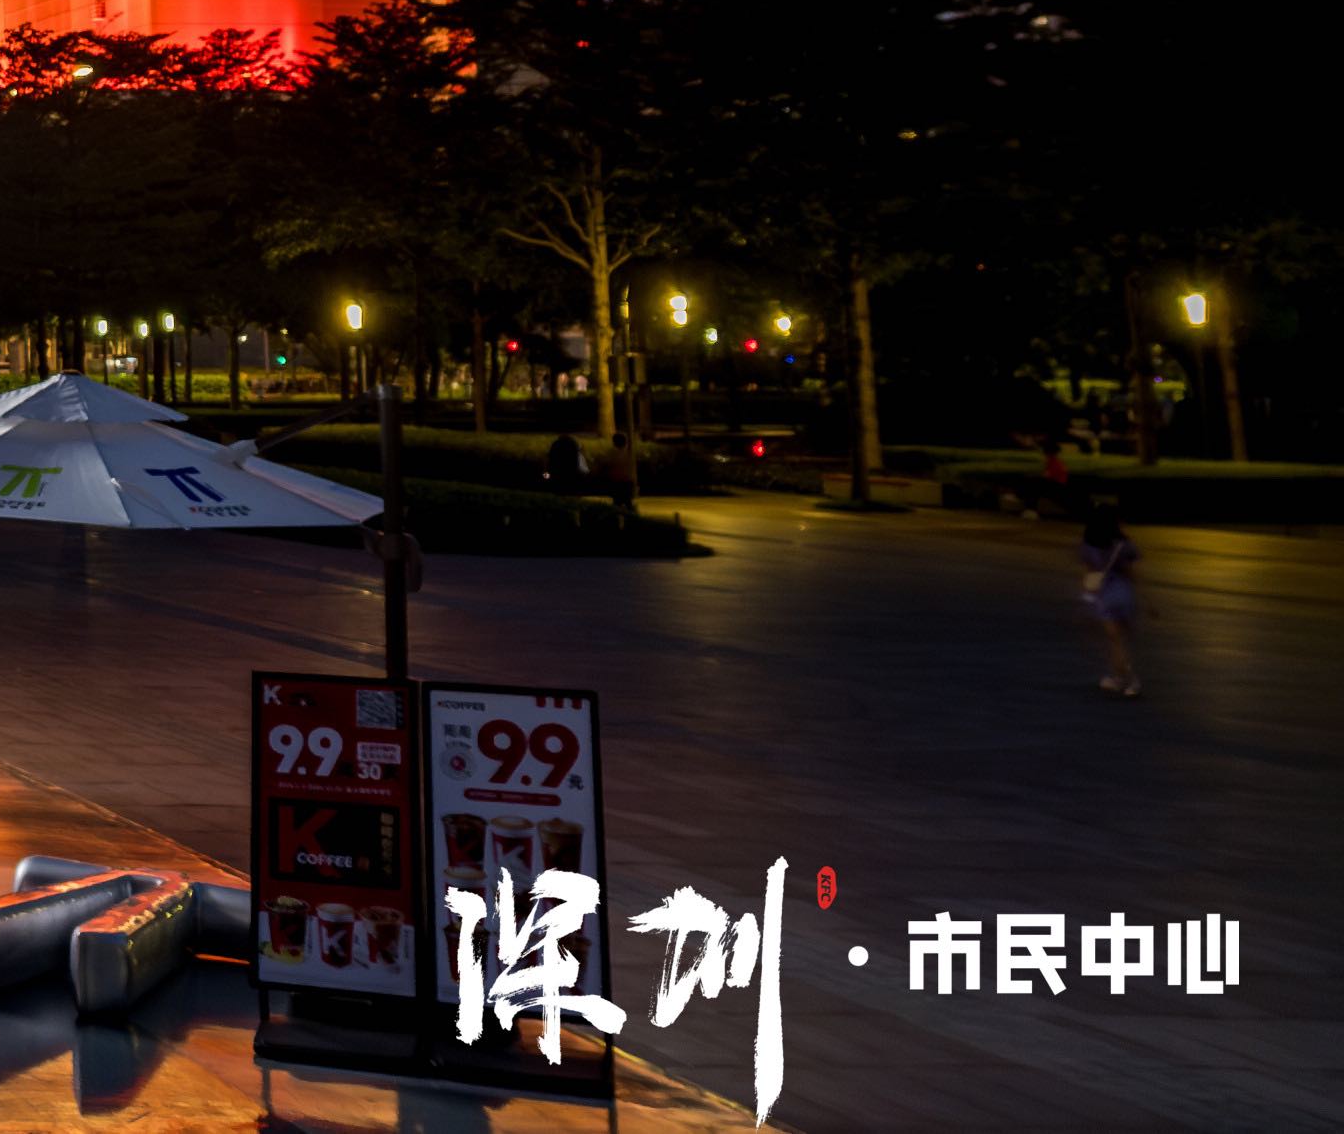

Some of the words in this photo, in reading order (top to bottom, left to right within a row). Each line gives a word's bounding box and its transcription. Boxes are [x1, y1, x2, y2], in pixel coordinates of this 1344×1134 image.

[268, 723, 343, 777] 9.9
[478, 719, 580, 788] 9.9
[296, 852, 353, 869] COFFEE
